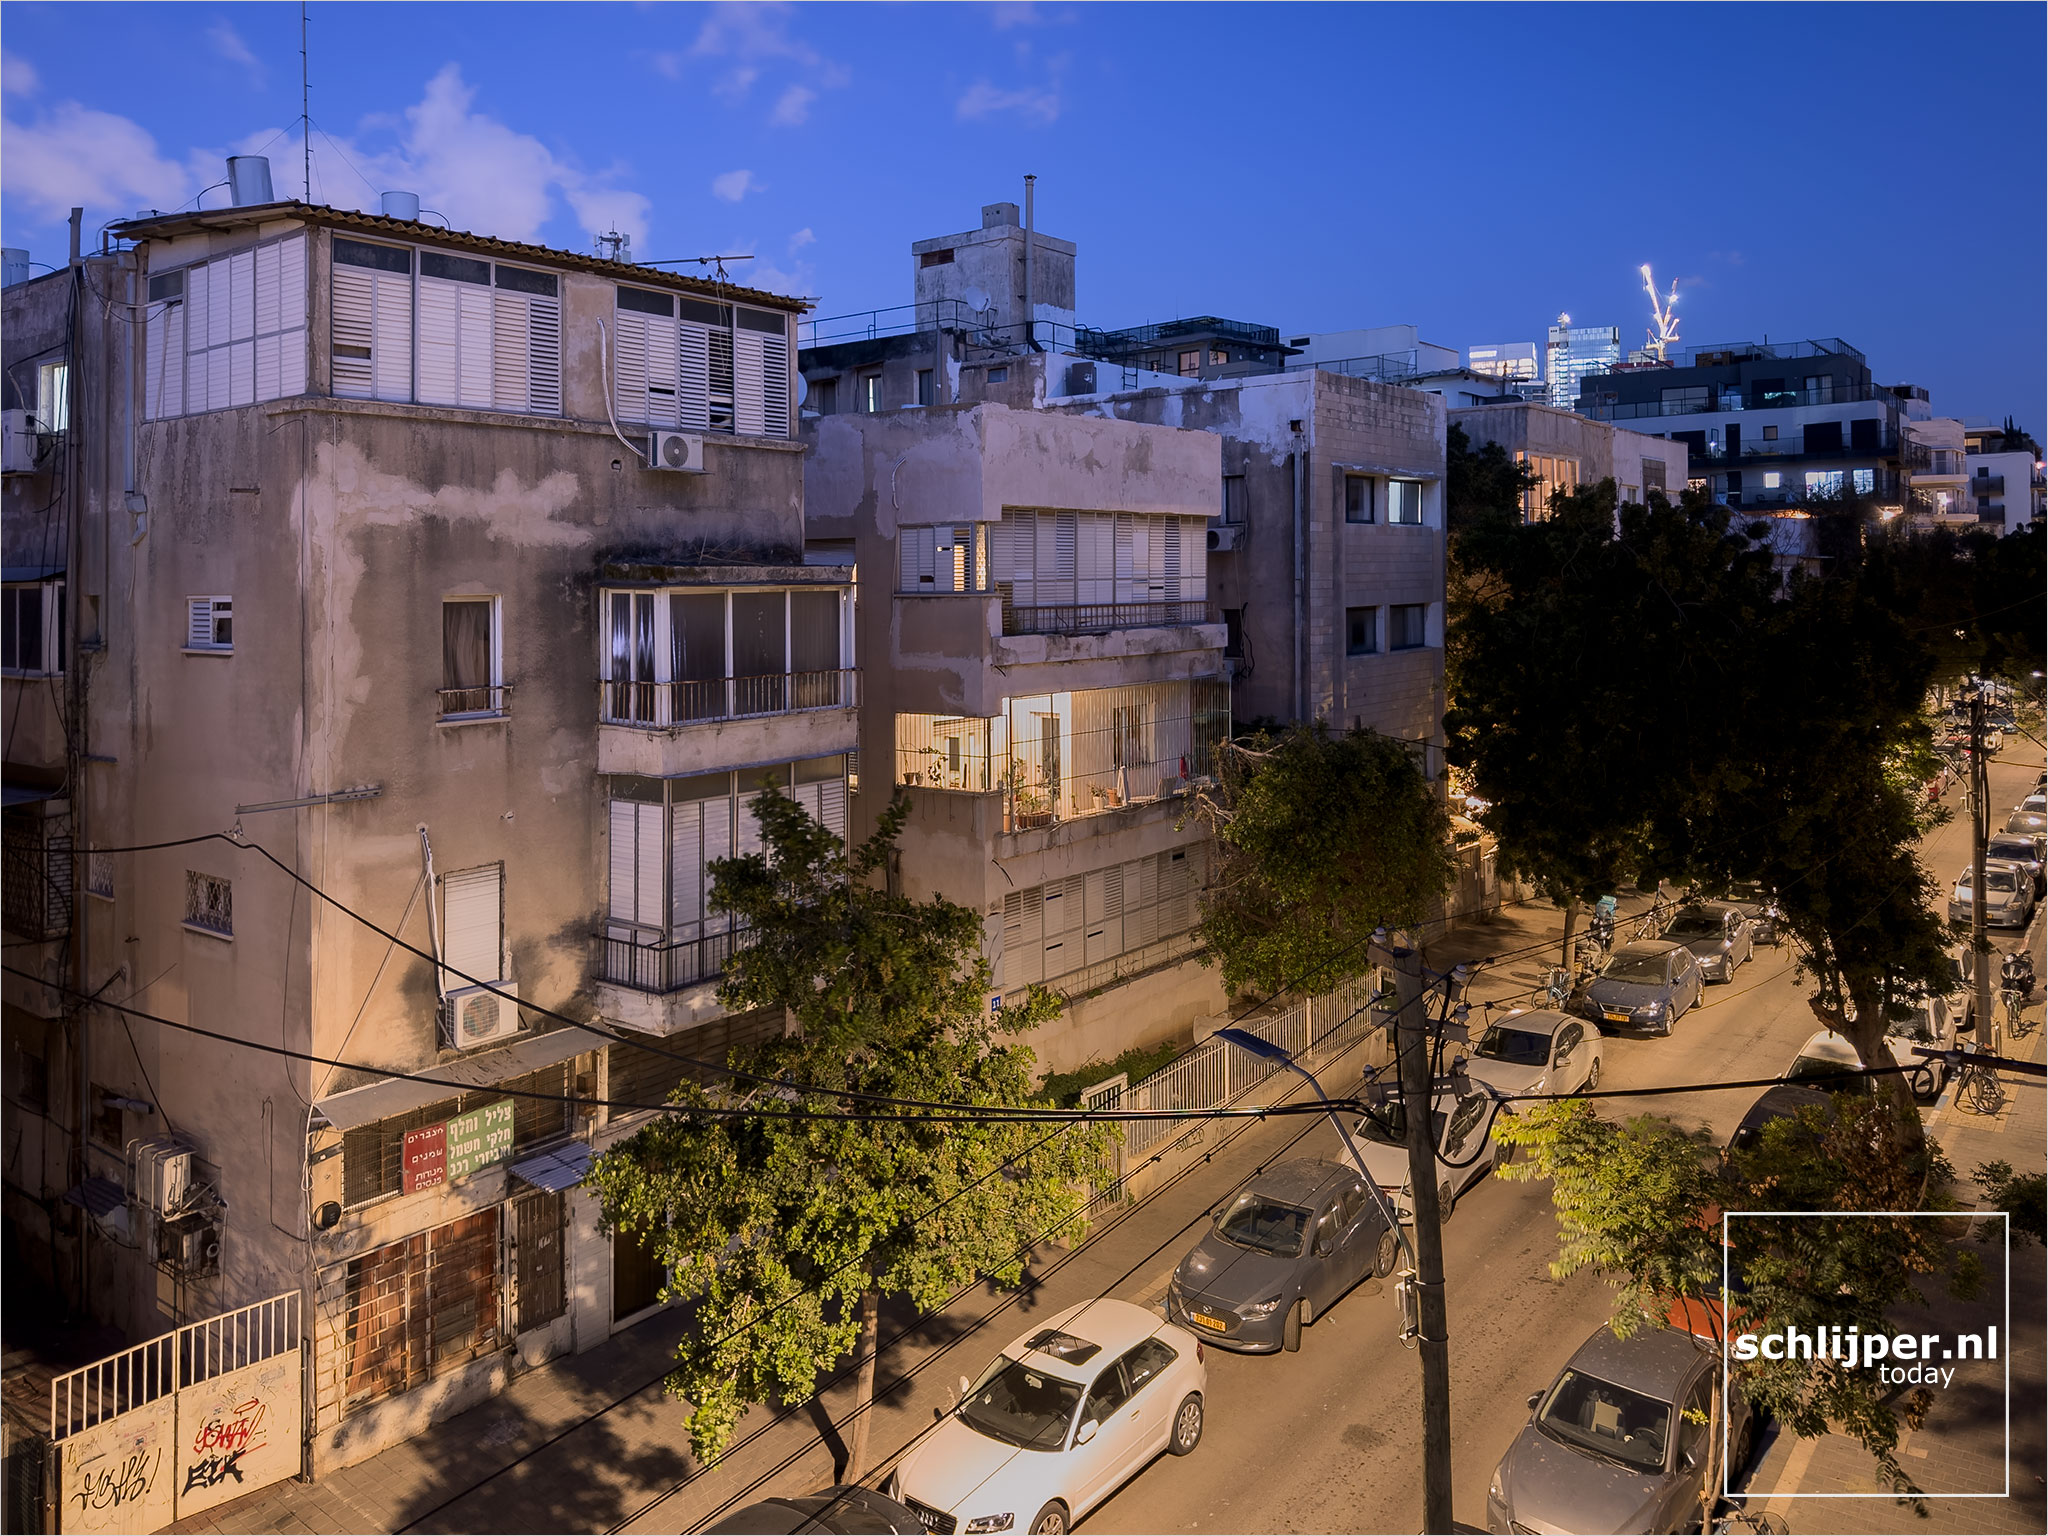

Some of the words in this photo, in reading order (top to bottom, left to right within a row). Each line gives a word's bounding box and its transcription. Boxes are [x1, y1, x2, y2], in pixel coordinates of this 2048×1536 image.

[485, 1105, 512, 1127] צליל
[407, 1127, 444, 1144] מצברים
[449, 1116, 479, 1142] וחלף
[486, 1127, 511, 1148] חלקי
[411, 1148, 443, 1164] שמנים
[449, 1137, 480, 1160] חשמל
[474, 1143, 511, 1165] ואביזרי
[449, 1158, 469, 1177] רכב
[415, 1176, 442, 1191] פנסים
